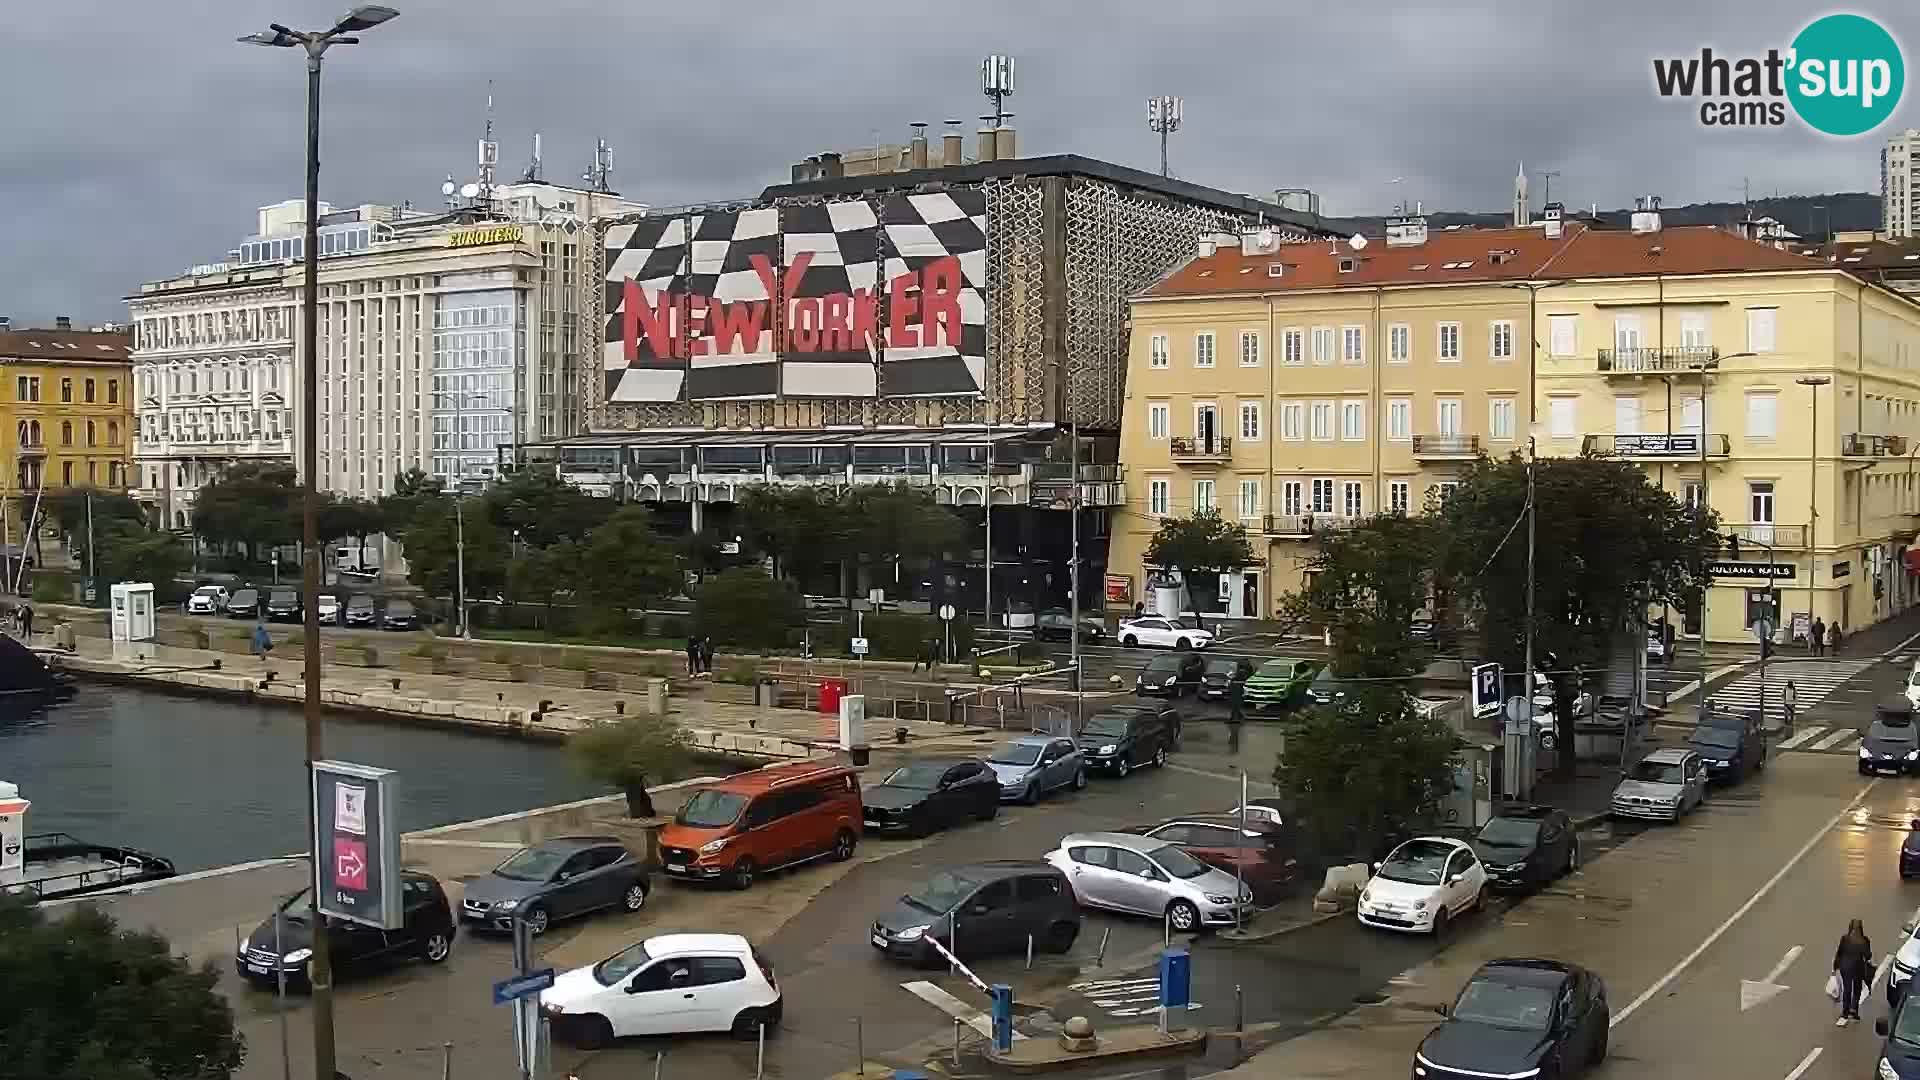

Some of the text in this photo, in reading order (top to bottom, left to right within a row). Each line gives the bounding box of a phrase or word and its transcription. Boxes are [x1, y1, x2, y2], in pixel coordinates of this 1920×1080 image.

[1708, 566, 1791, 576] JULIANA NAILS
[1483, 670, 1495, 694] P
